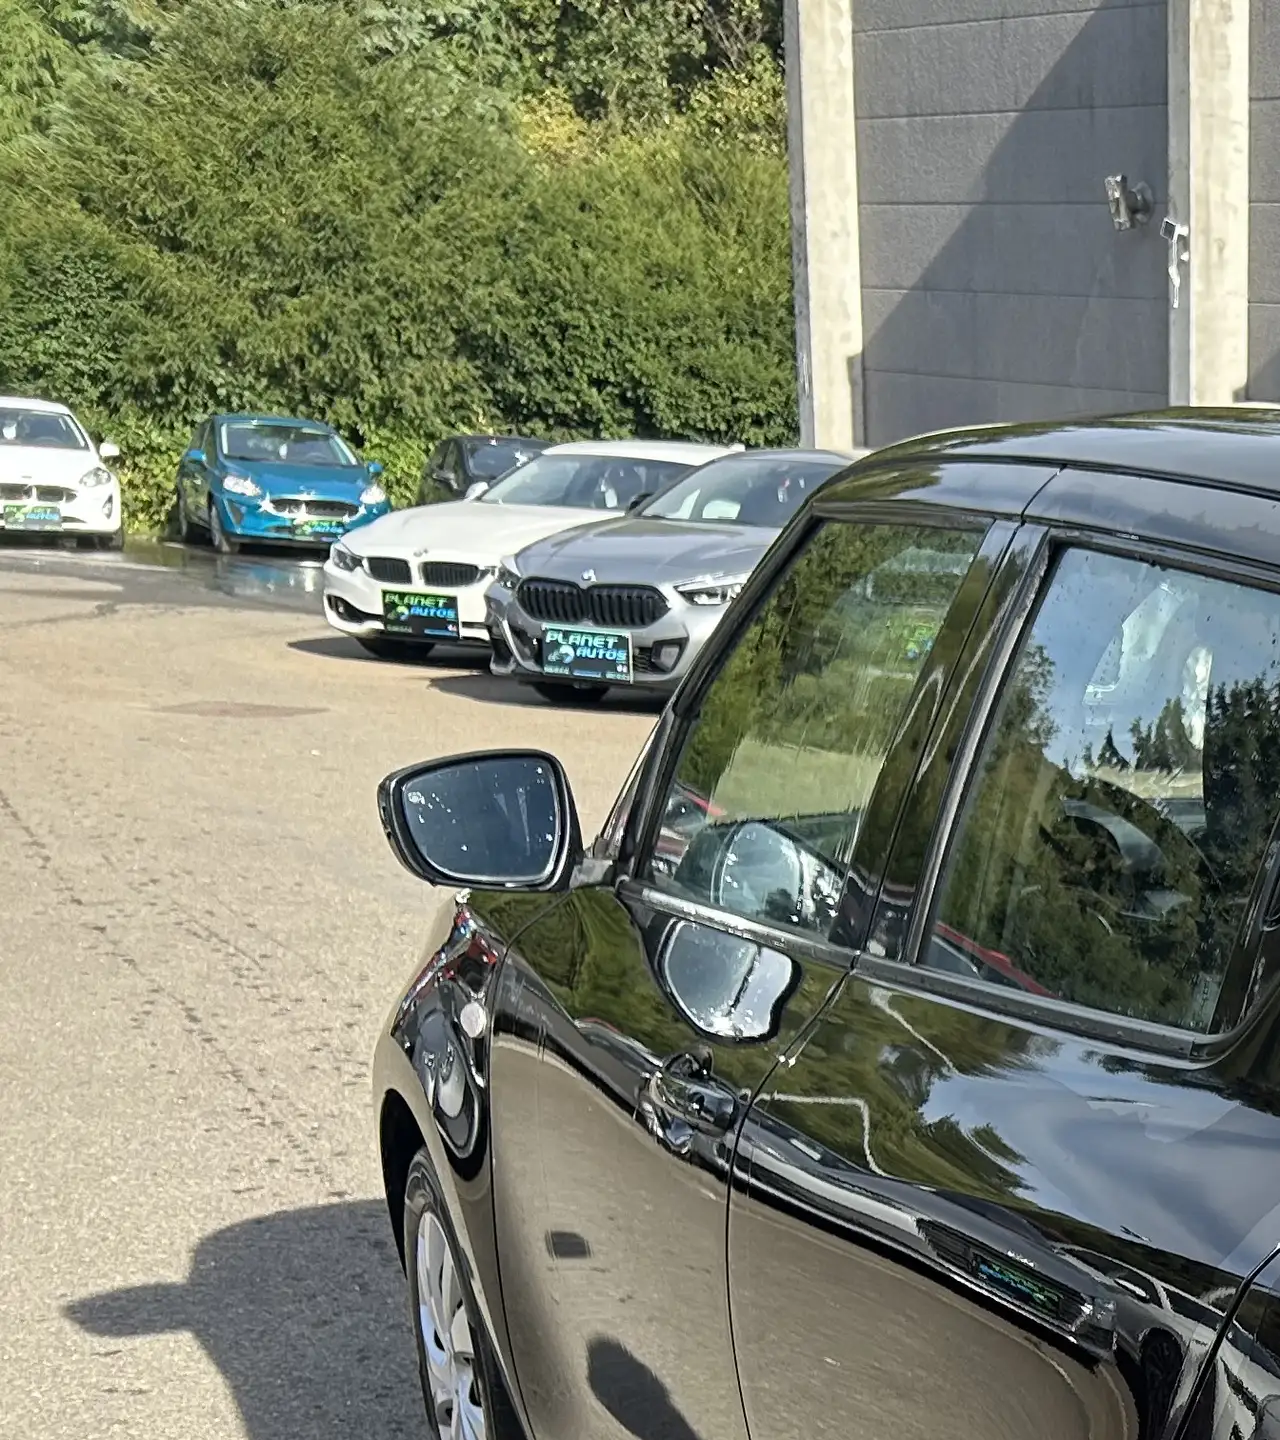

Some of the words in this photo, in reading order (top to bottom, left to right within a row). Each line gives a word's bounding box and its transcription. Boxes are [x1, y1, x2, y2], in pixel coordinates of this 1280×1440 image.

[385, 593, 448, 609] PLANET
[410, 605, 457, 620] AUTOS
[545, 630, 619, 650] PLANET
[576, 645, 628, 662] AUTOS
